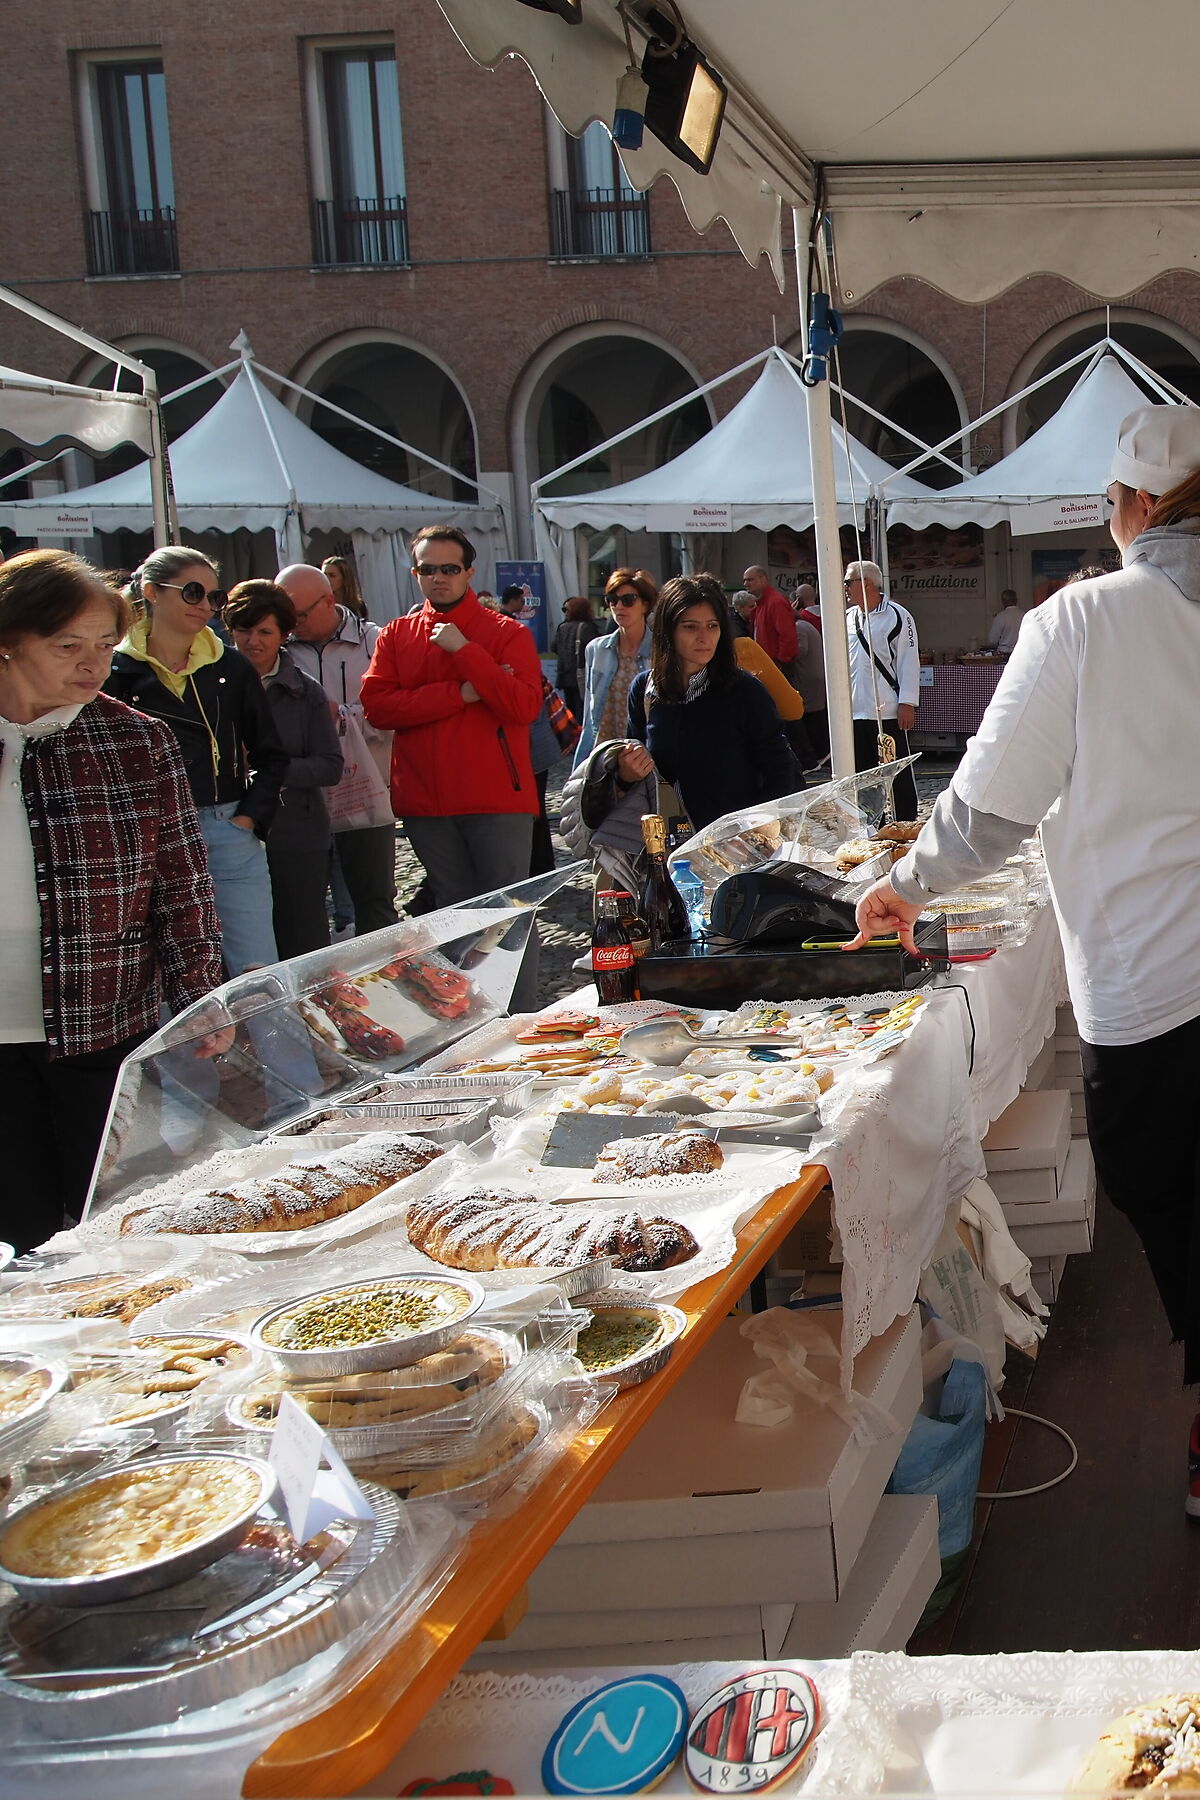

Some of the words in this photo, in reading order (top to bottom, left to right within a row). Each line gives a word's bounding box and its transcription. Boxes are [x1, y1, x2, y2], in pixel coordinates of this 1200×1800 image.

[1060, 503, 1098, 513] Bonissima
[1069, 515, 1099, 525] SALUMIFICIO
[900, 574, 978, 589] Tradizione
[596, 947, 630, 962] Coca-Cola
[574, 1706, 646, 1756] N
[699, 1766, 772, 1788] 1899
